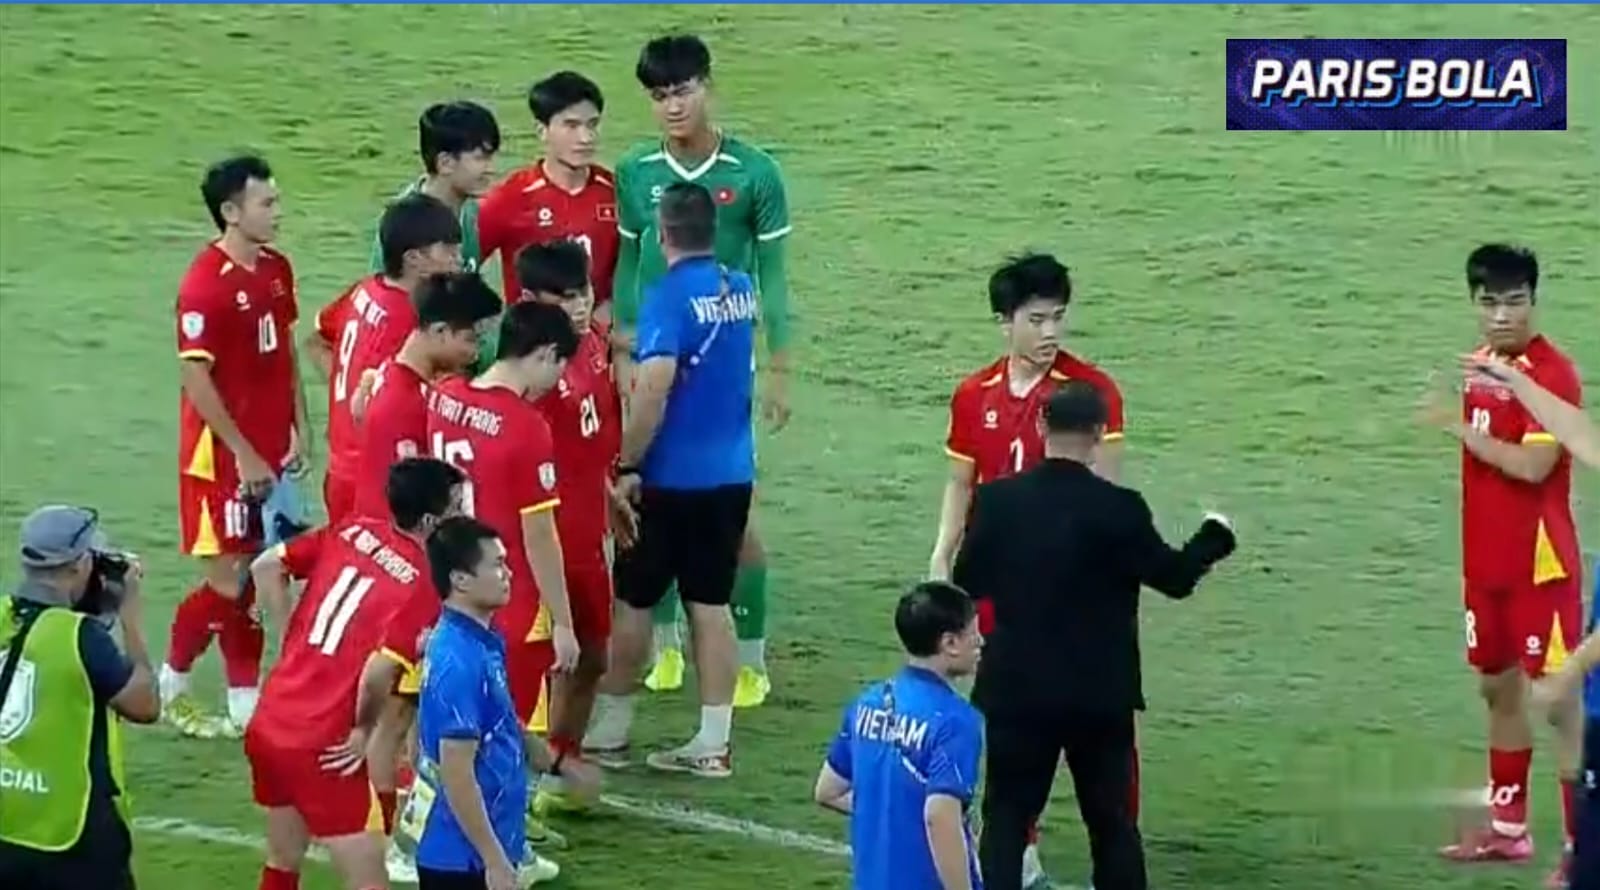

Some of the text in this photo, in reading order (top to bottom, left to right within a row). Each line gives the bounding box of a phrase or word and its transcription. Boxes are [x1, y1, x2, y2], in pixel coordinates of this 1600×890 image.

[258, 312, 278, 354] 10
[334, 319, 358, 402] 9
[580, 392, 600, 438] 21
[224, 498, 249, 539] 10
[307, 565, 375, 656] 11
